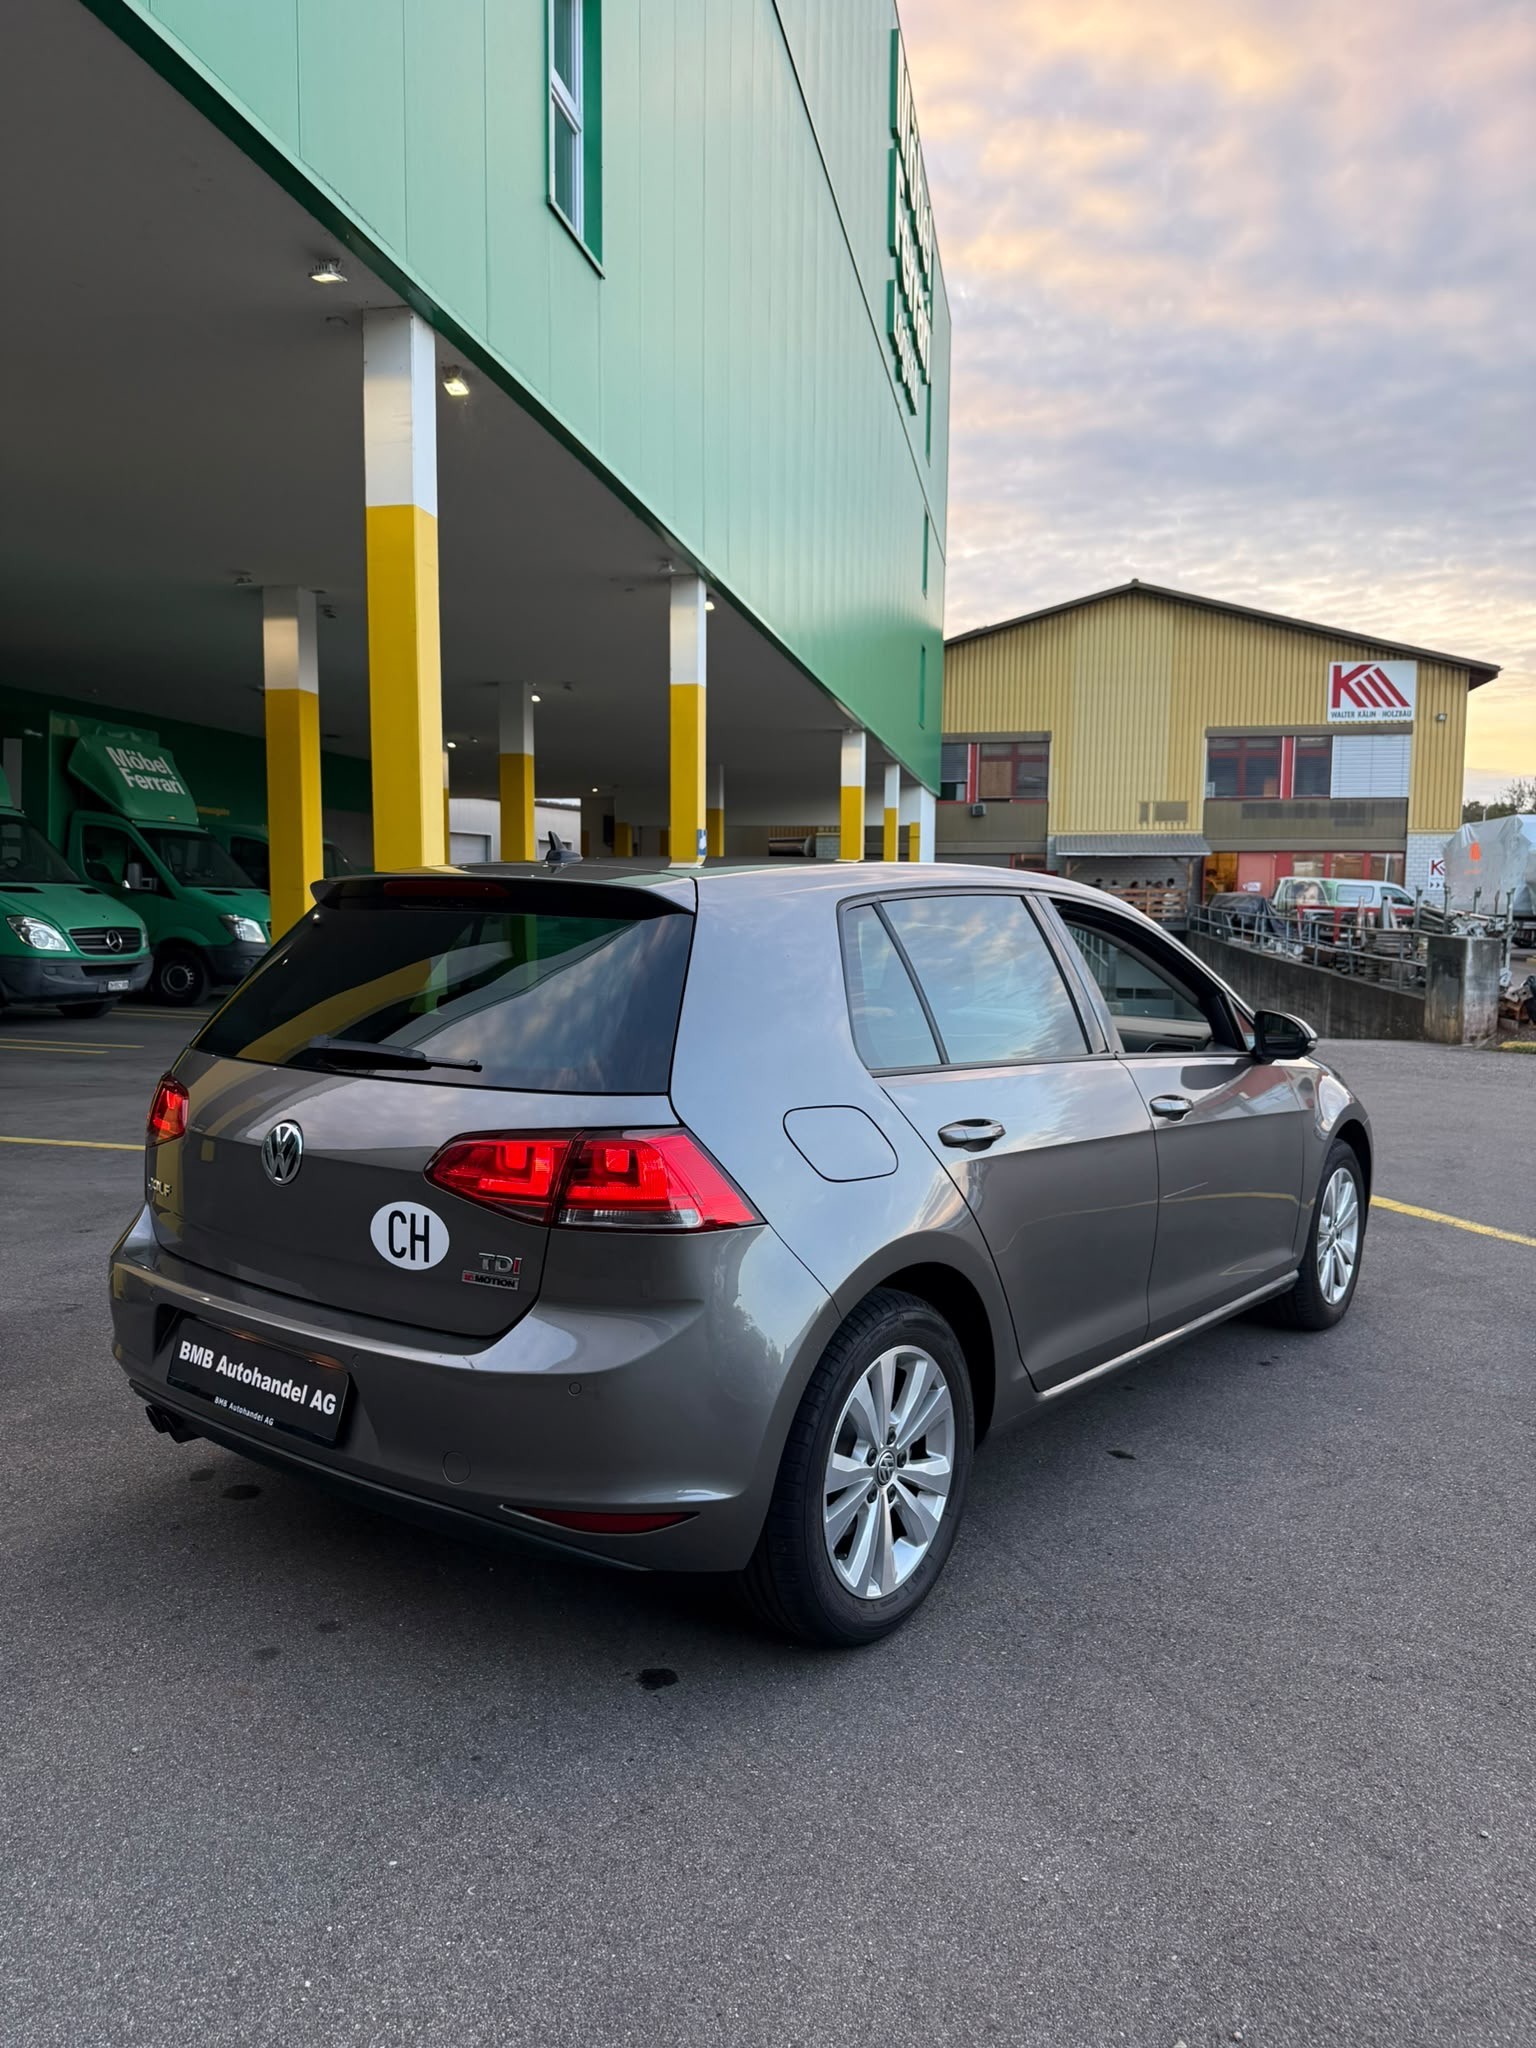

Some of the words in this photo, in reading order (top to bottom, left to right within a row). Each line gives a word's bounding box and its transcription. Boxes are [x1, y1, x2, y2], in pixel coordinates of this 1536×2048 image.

[1331, 711, 1355, 719] WALTER
[1382, 710, 1412, 718] HOLZBAU
[105, 746, 173, 775] Möbel
[119, 767, 186, 795] Ferrari
[388, 1210, 430, 1263] CH
[179, 1340, 215, 1369] BMB
[216, 1355, 308, 1404] Autohandel
[309, 1390, 337, 1415] AG
[214, 1396, 228, 1408] BMB
[229, 1402, 264, 1422] Autohandel
[264, 1416, 274, 1426] AG
